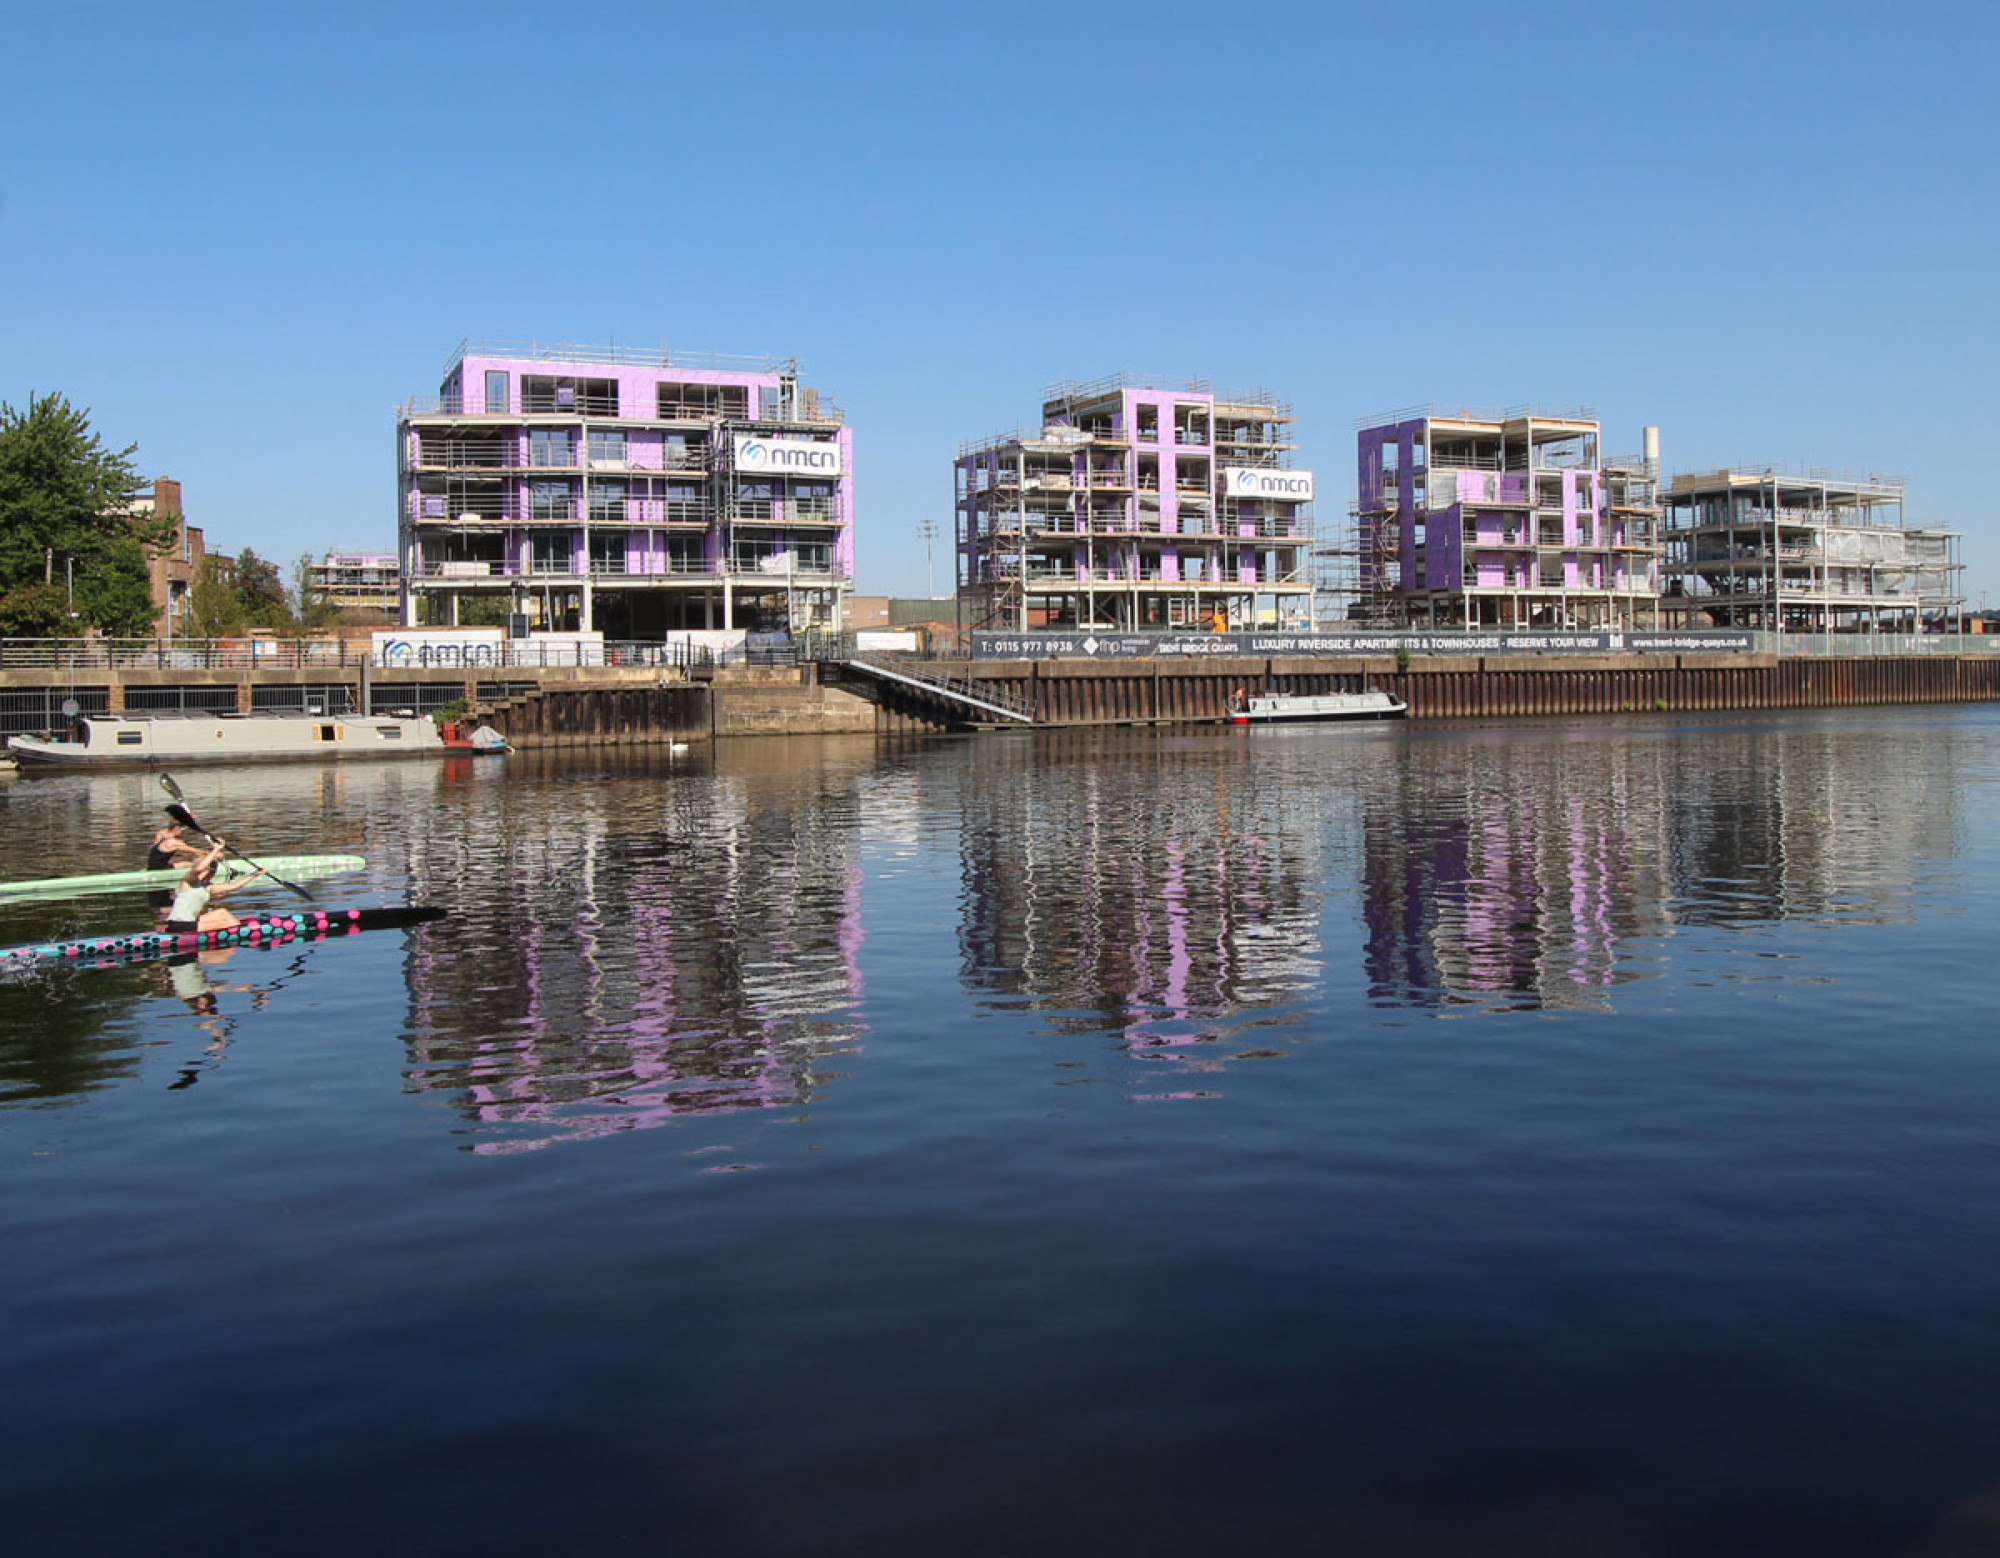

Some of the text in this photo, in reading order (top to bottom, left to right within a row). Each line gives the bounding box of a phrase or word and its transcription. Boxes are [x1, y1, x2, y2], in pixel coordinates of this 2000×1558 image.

[771, 447, 836, 468] nmcn
[1261, 476, 1309, 493] nmcn
[981, 640, 1073, 652] T: 0115 977 8938
[1252, 639, 1295, 650] LUXURY
[1298, 638, 1351, 649] RIVERSIDE
[1421, 638, 1429, 648] &
[1431, 637, 1499, 649] TOWNHOUSES
[1506, 637, 1548, 648] RESERVE
[1549, 637, 1576, 648] YOUR
[1576, 637, 1599, 648] VIEW
